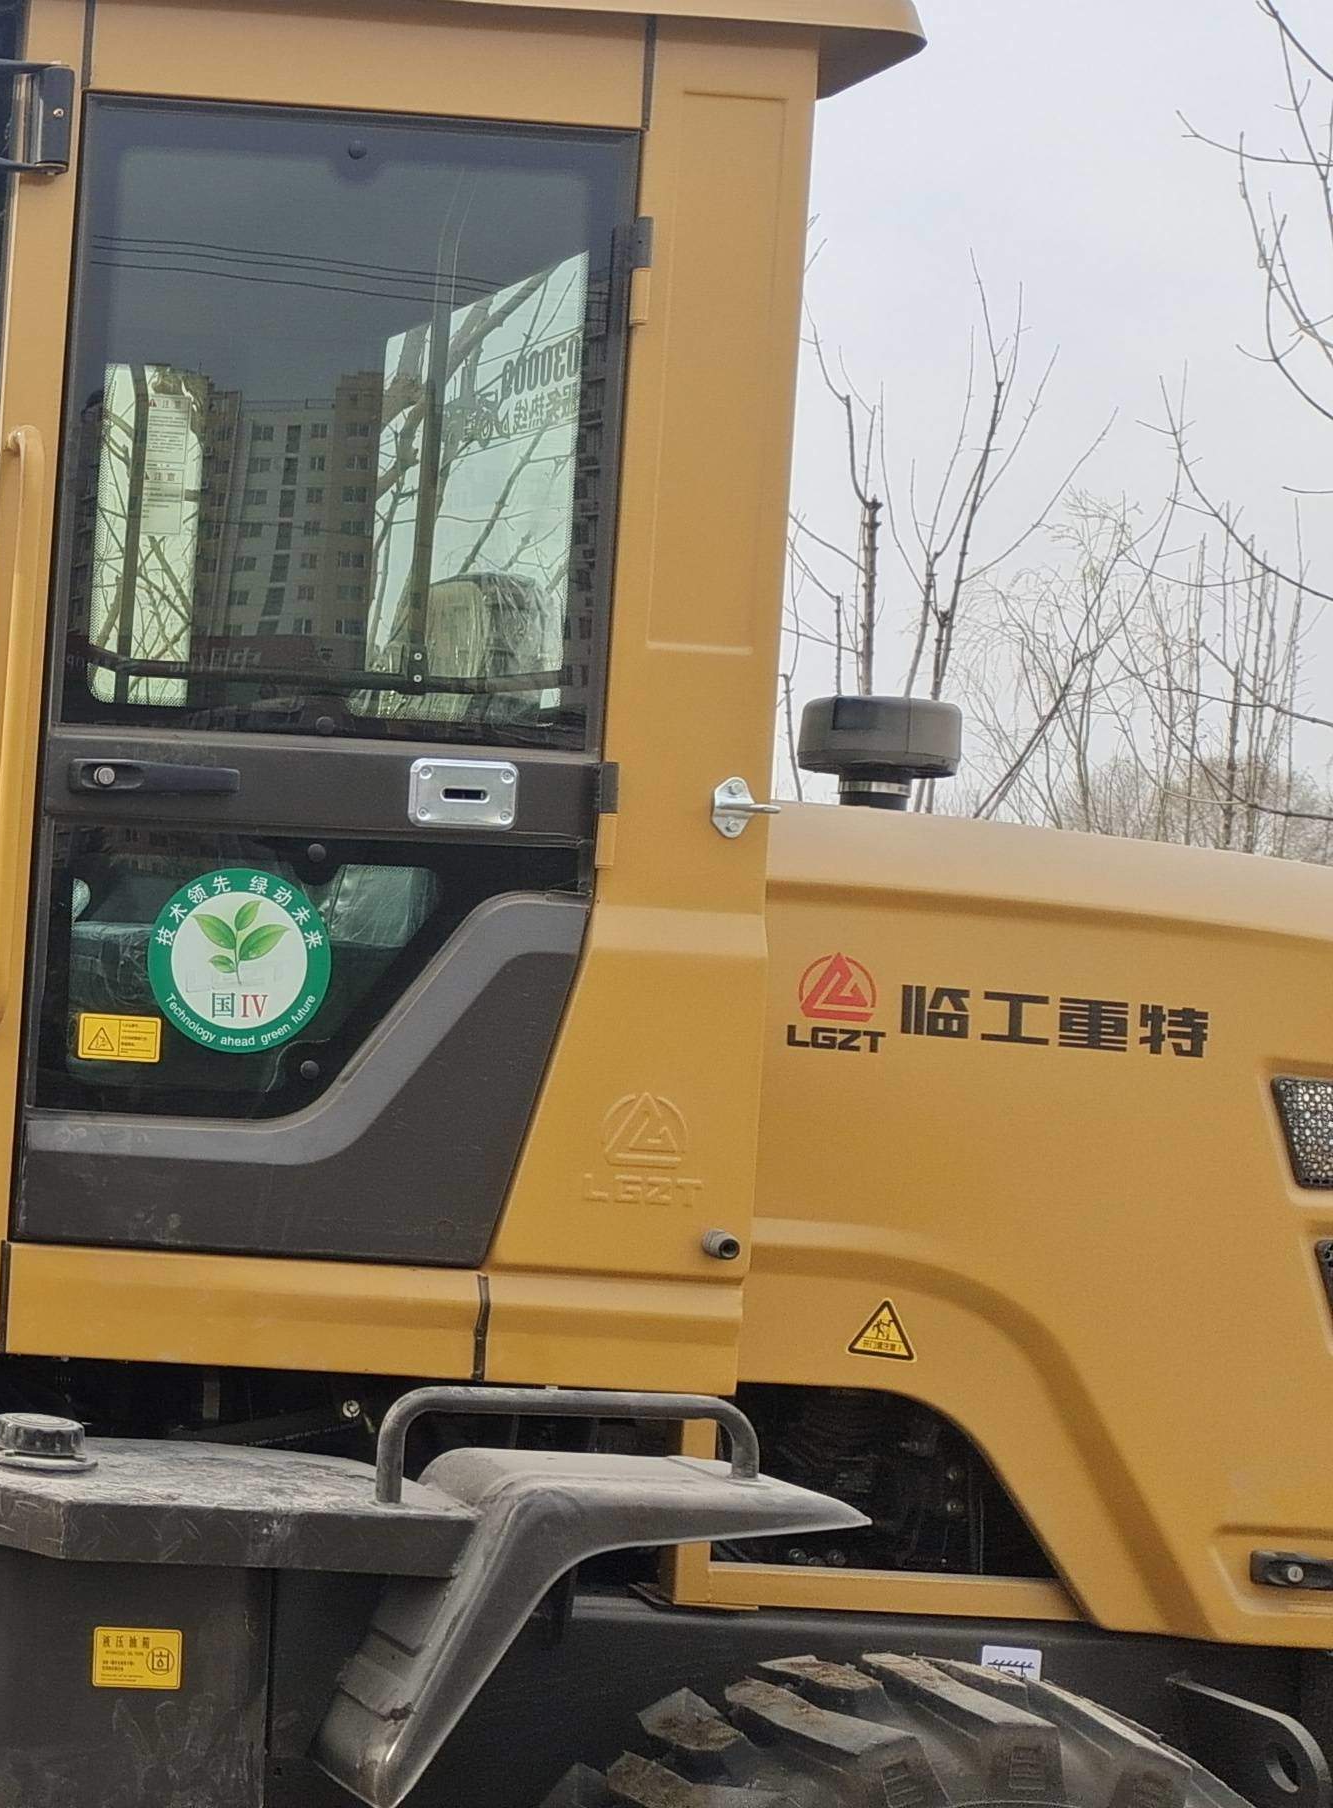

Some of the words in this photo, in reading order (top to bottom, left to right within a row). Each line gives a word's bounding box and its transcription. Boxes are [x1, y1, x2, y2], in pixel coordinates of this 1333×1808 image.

[154, 874, 232, 946] 技术领先
[248, 875, 323, 950] 绿动未来
[165, 994, 217, 1044] Technology
[220, 1034, 256, 1047] ahead
[261, 1023, 292, 1045] green
[291, 994, 317, 1025] future
[786, 1023, 887, 1053] LGZT
[900, 983, 1210, 1058] 临工重特
[584, 1172, 704, 1208] LGZT
